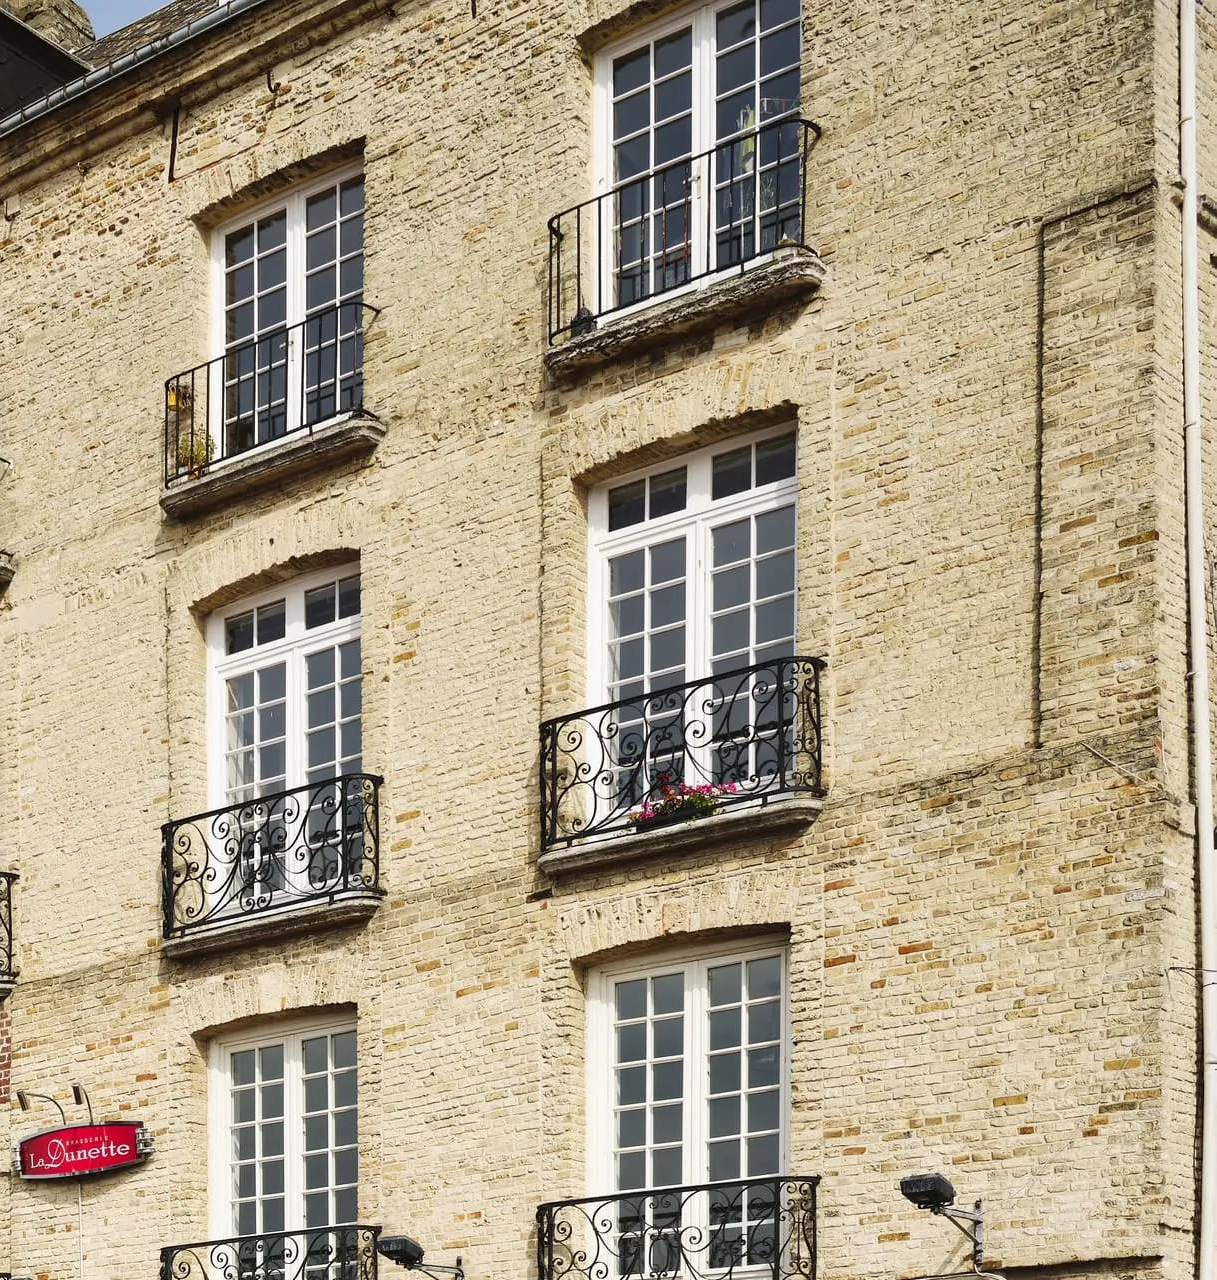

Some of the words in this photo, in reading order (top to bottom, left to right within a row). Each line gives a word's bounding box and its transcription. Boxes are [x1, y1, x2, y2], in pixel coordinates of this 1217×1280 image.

[65, 1135, 109, 1146] BRASSERIE
[30, 1153, 45, 1169] La
[44, 1139, 130, 1169] Dunette
